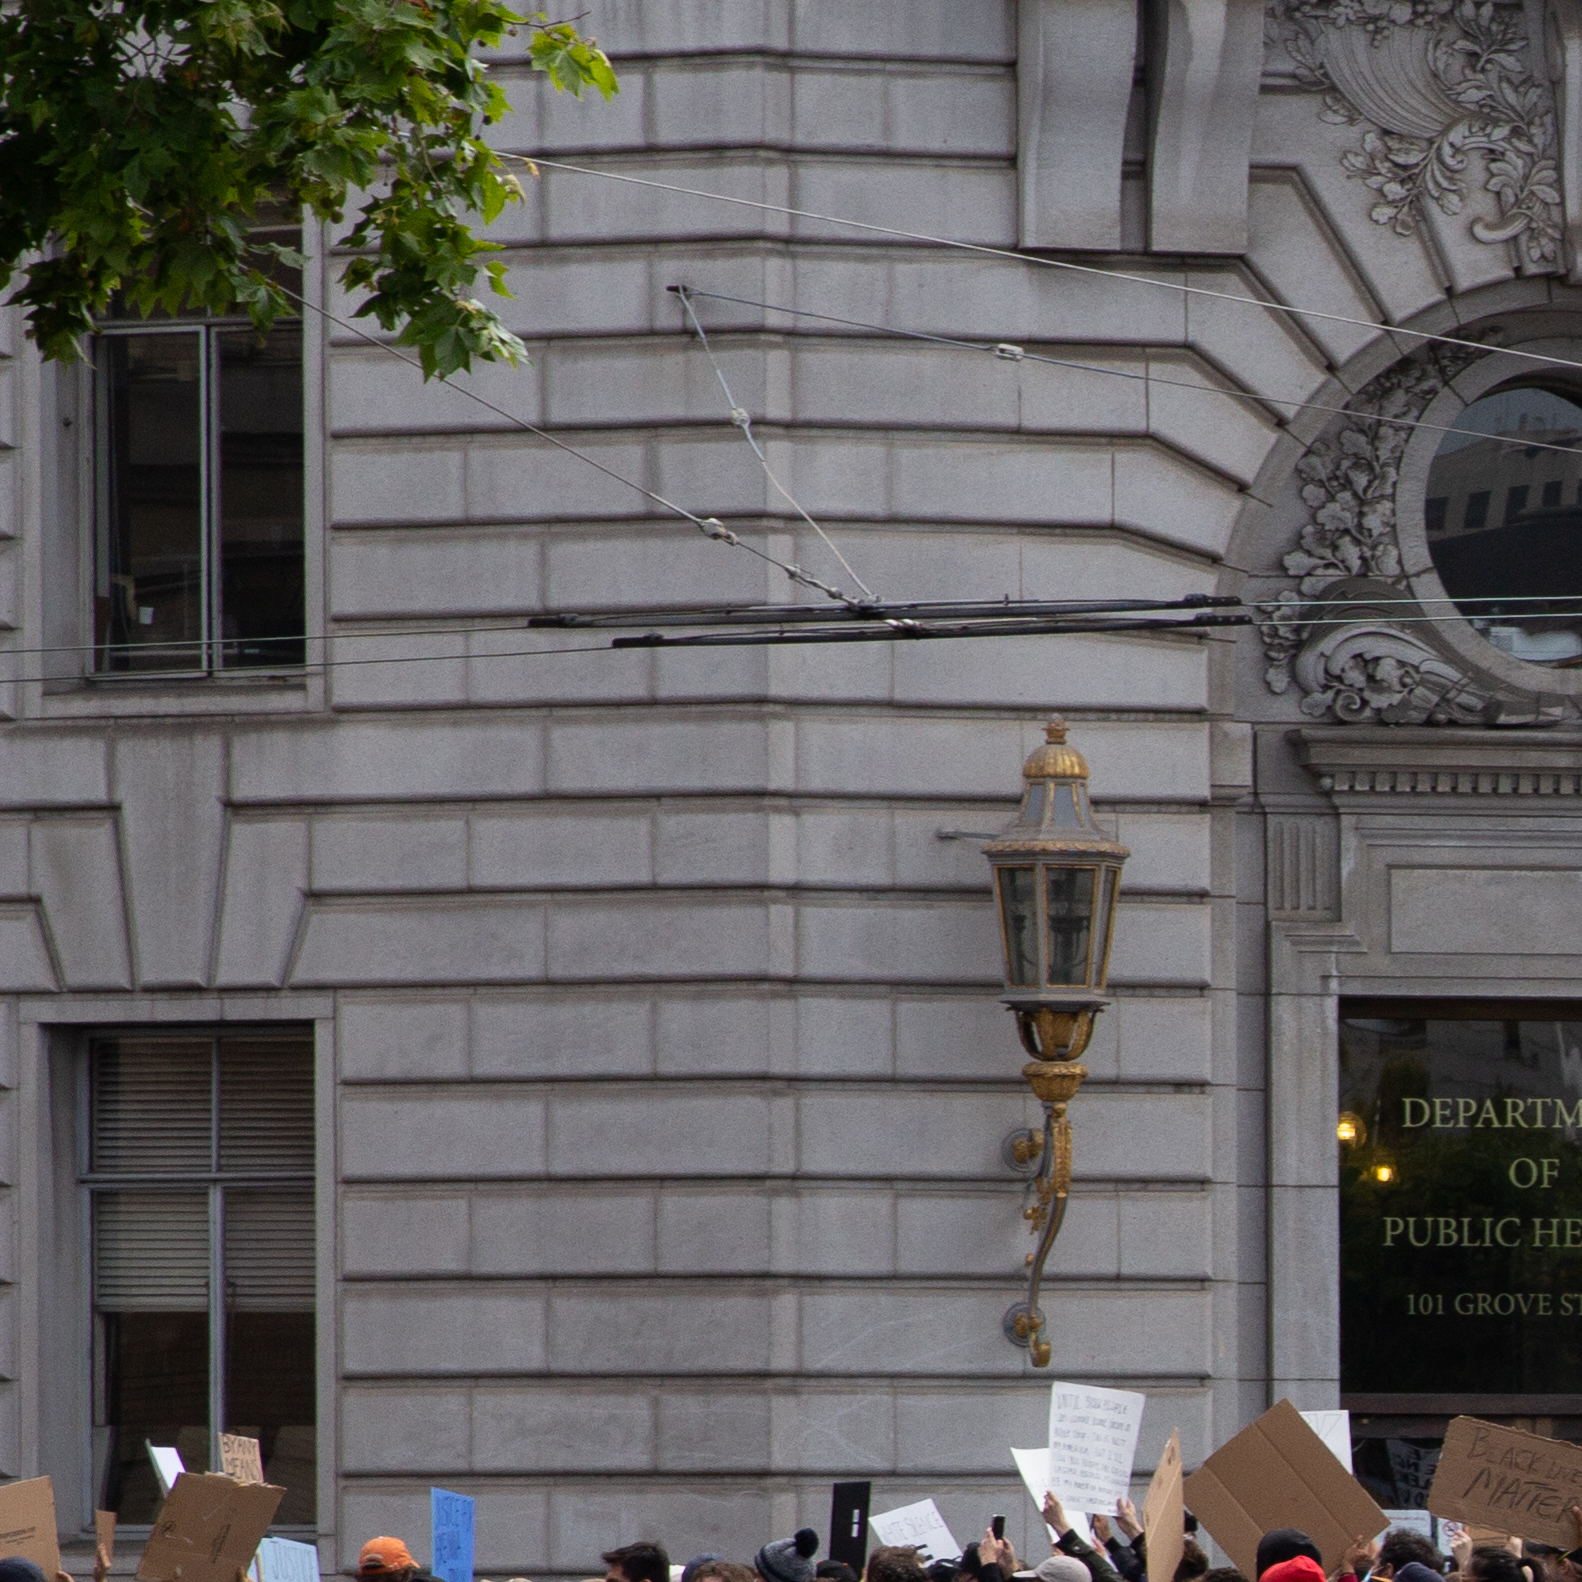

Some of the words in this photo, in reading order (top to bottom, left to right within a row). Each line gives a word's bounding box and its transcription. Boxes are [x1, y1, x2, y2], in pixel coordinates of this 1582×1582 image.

[1508, 1158, 1560, 1188] OF
[1382, 1217, 1522, 1248] PUBLIC
[1406, 1295, 1445, 1316] 101
[1454, 1294, 1553, 1317] GROVE
[1467, 1426, 1547, 1474] BLACK
[1462, 1466, 1580, 1524] MATTER
